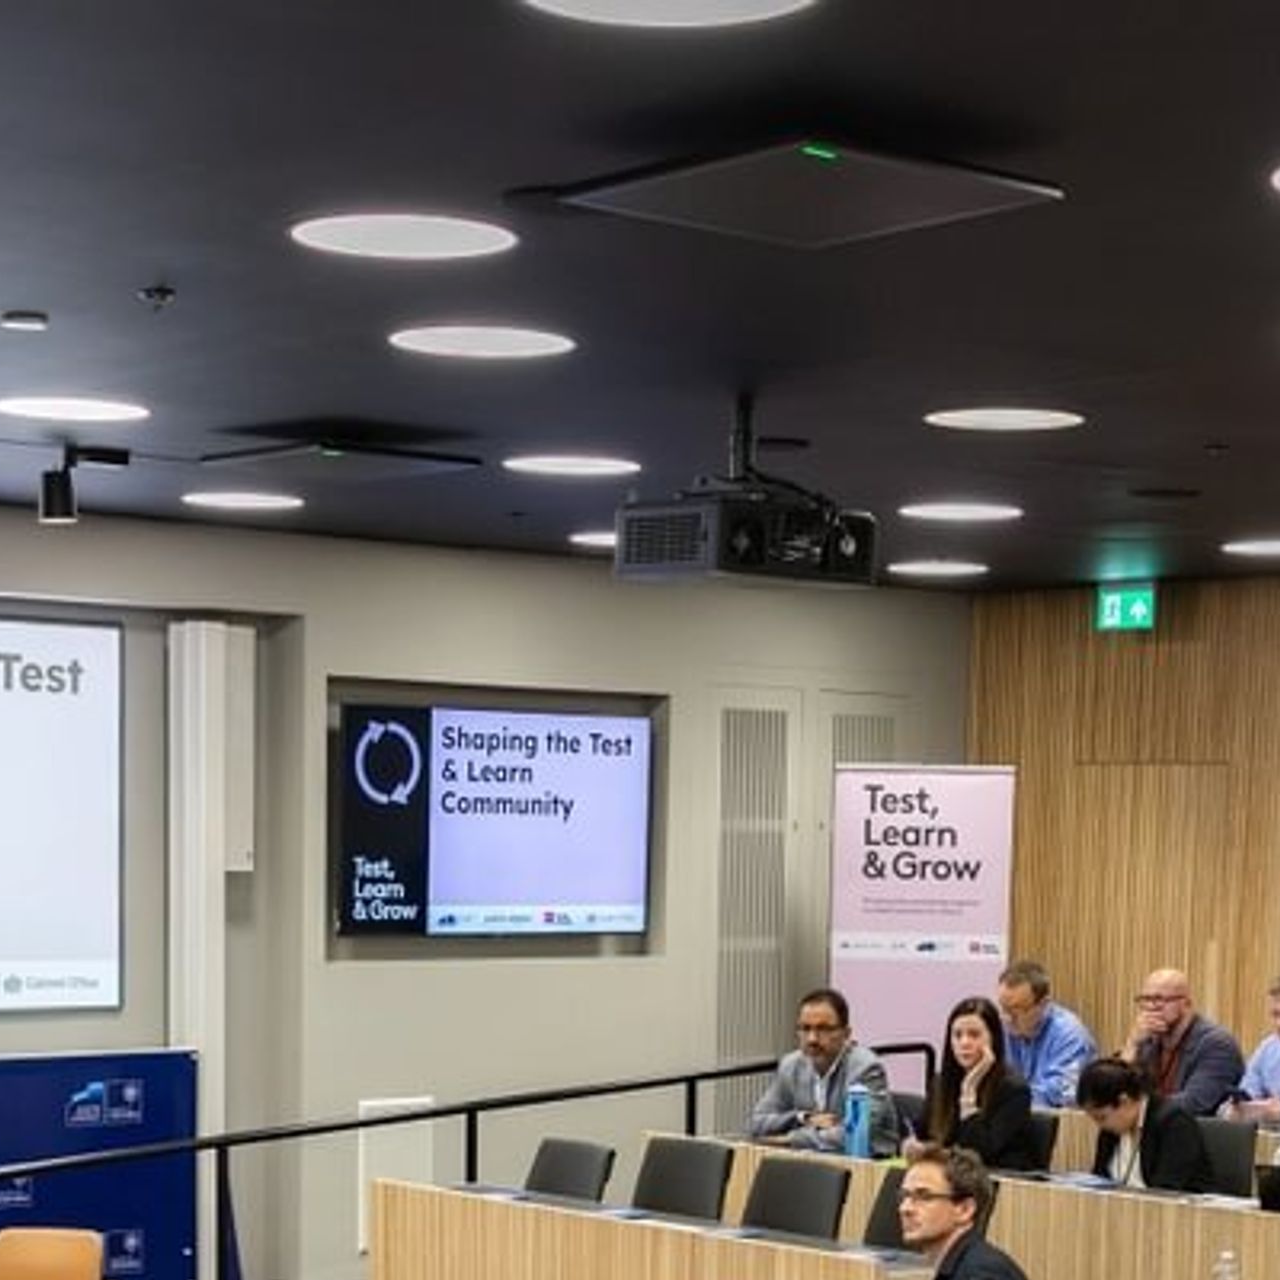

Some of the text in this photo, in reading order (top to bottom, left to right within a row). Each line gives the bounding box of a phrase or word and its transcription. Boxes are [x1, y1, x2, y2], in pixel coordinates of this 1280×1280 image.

[441, 726, 633, 760] Shaping the Test
[442, 759, 533, 783] & Learn
[441, 791, 575, 822] Community
[864, 784, 939, 819] Test,
[864, 819, 958, 848] Learn
[353, 857, 395, 880] Test,
[862, 851, 981, 881] & Grow
[353, 879, 405, 899] Learn
[370, 898, 418, 921] Grow
